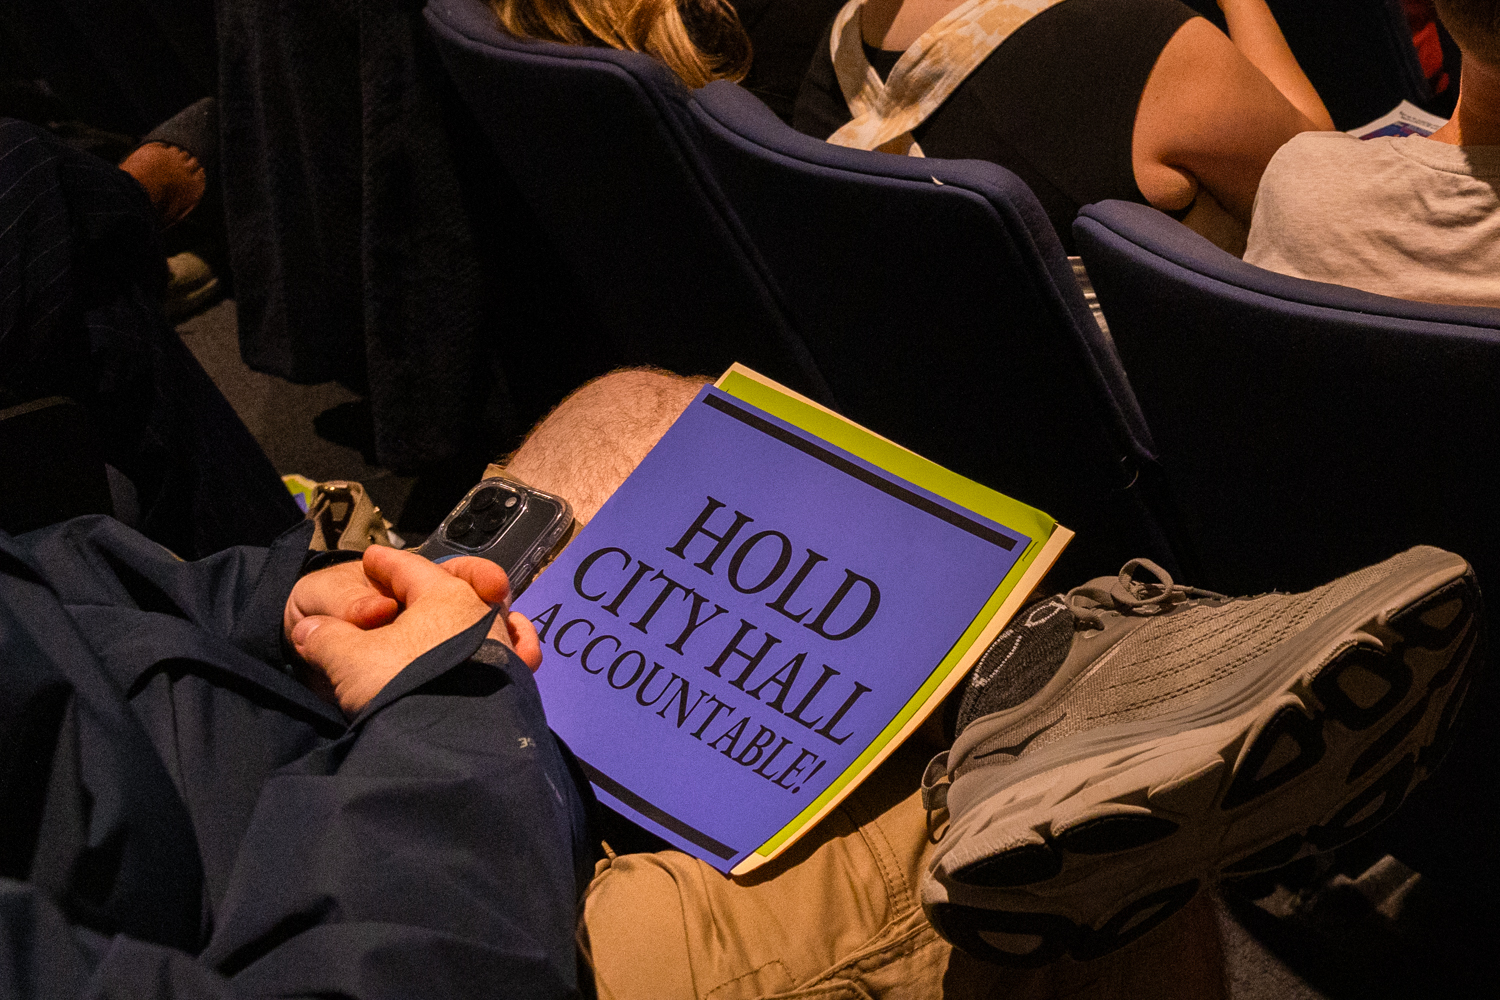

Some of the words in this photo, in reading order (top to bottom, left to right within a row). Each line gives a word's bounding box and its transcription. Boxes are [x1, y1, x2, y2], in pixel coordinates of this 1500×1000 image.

[573, 547, 729, 656] CITY
[704, 618, 872, 746] HALL
[665, 495, 881, 641] HOLD
[530, 603, 827, 795] ACCOUNTABLE!
